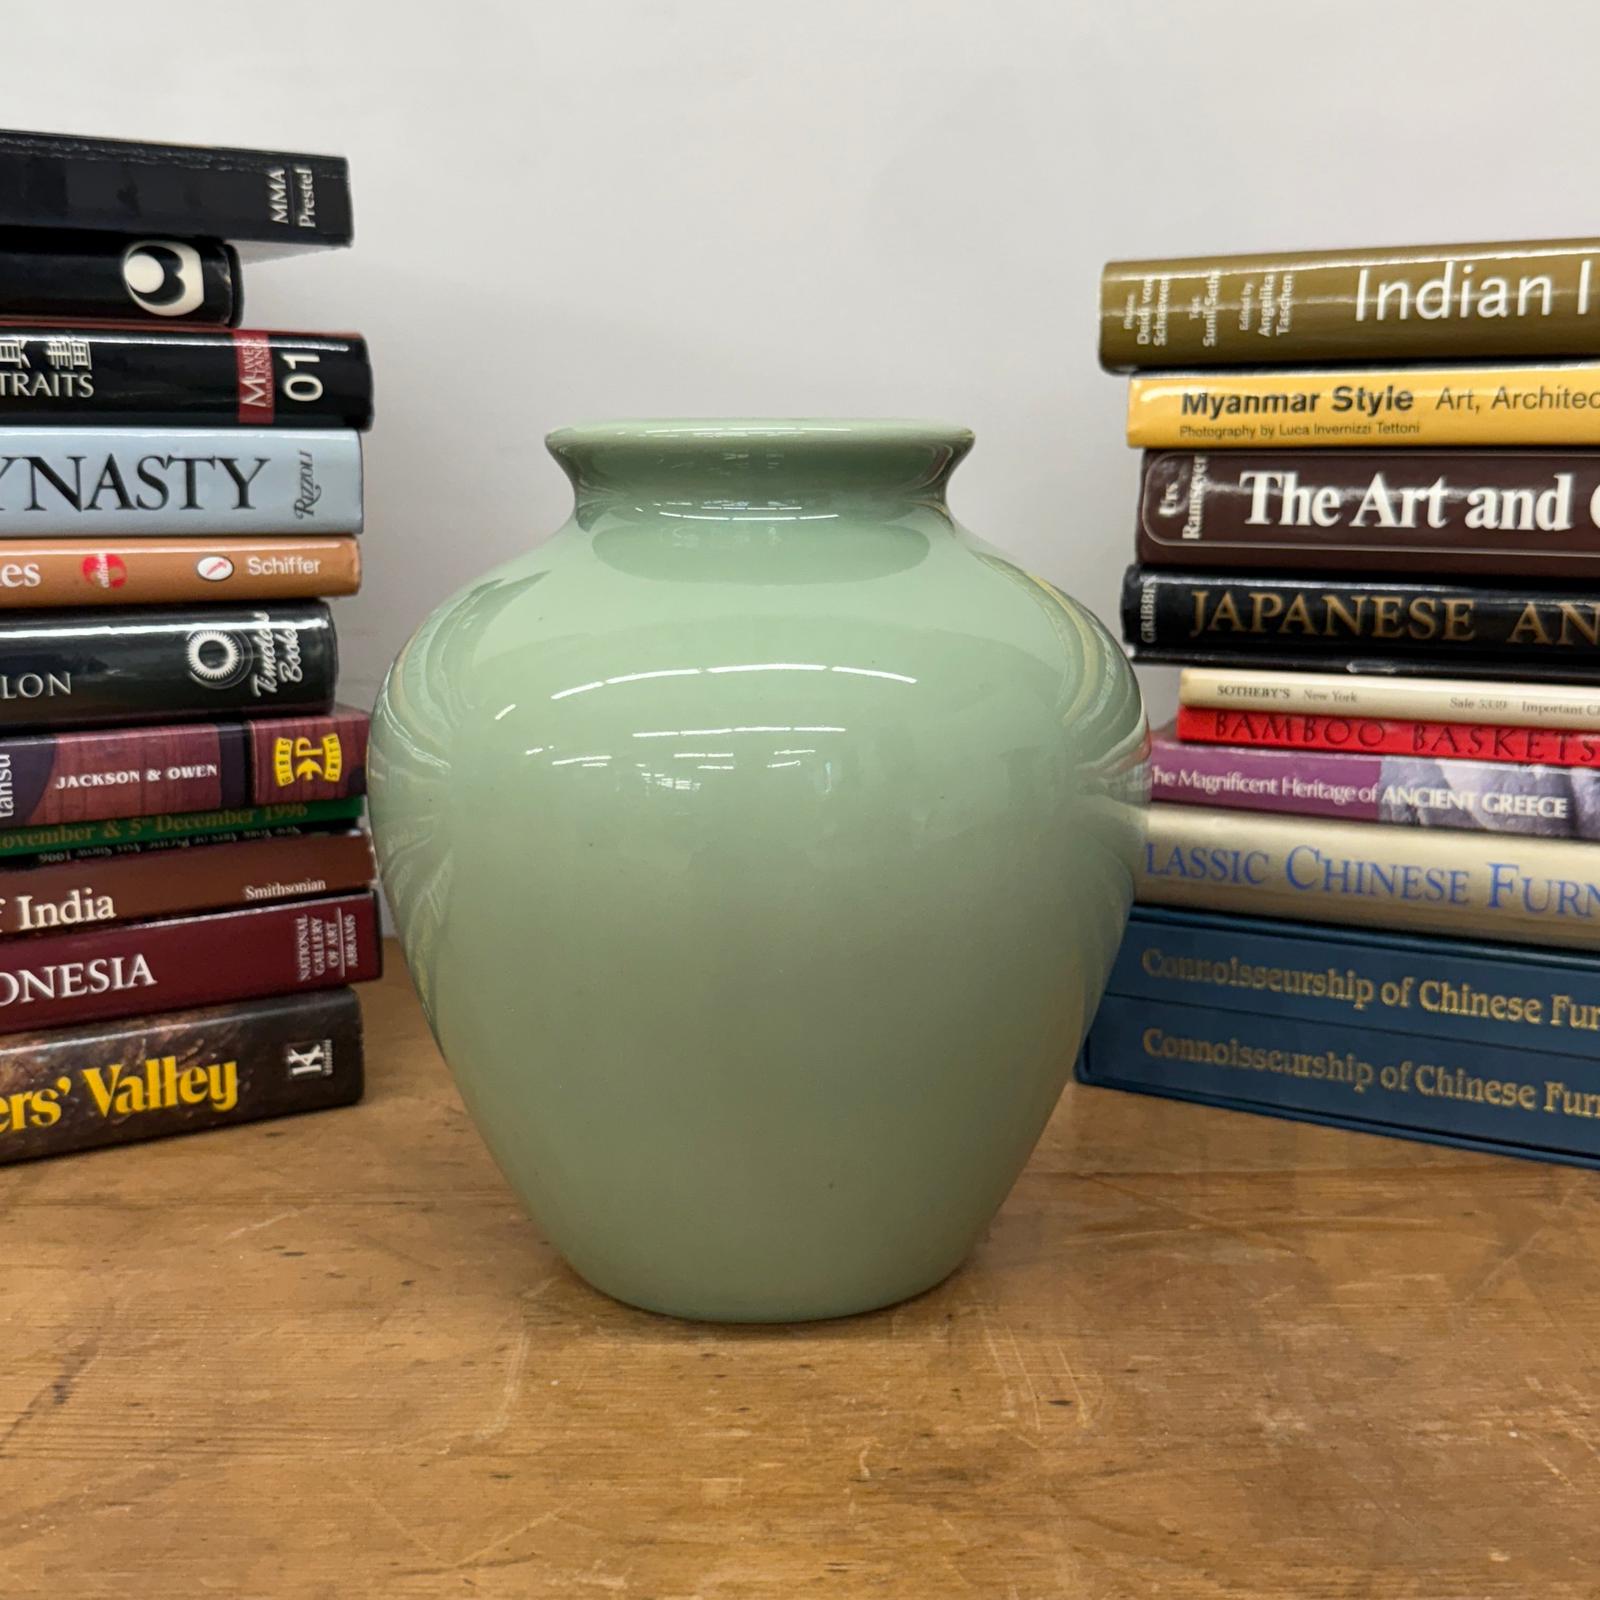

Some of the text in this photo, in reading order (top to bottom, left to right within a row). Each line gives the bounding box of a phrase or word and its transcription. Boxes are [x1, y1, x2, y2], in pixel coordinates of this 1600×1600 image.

[269, 168, 289, 224] MMA
[295, 168, 316, 227] Prestel
[1240, 281, 1254, 331] Edited by
[1258, 273, 1275, 337] Angelika
[1275, 275, 1292, 336] Taschen
[1355, 261, 1552, 322] Indian
[1136, 308, 1151, 345] Deidi
[1203, 310, 1217, 347] Sunil
[0, 372, 94, 398] TRAITS
[282, 352, 324, 402] 01
[1180, 385, 1600, 420] Myanmar Style Art, Architec
[1179, 421, 1420, 440] Photography by Luca Invernizzi Tettoni
[1158, 481, 1177, 517] Urs
[1182, 455, 1207, 540] Ramseyer
[1239, 470, 1342, 527] The
[1349, 472, 1449, 529] Art
[1464, 474, 1575, 532] and
[0, 562, 41, 587] es
[247, 555, 322, 577] Schiffer
[1189, 589, 1600, 645] JAPANESE AN
[0, 671, 72, 699] LON
[1217, 685, 1291, 699] SOTHEBY'S
[1304, 689, 1329, 702] New
[1332, 690, 1358, 703] York
[1449, 697, 1474, 709] Sale
[1522, 701, 1584, 716] Important
[1213, 713, 1597, 763] BAMBOO BASKETS
[55, 764, 217, 790] JACKSON & OWEN
[1152, 765, 1568, 819] he Magnificent Heritage of ANCIENT GREECE
[0, 825, 96, 850] ovember
[103, 820, 121, 838] &
[157, 809, 255, 832] December
[245, 878, 327, 901] Smithsonian
[1145, 841, 1270, 884] LASSIC
[1286, 844, 1471, 908] CHINESE
[16, 887, 117, 930] India
[296, 914, 311, 981] NATIONAL
[311, 917, 326, 976] GALLERY
[326, 921, 339, 967] OF ART
[344, 914, 358, 967] ABRAMS
[1141, 948, 1374, 1010] Connoisseurship
[1380, 977, 1415, 1008] of
[1419, 980, 1542, 1025] Chinese
[82, 1055, 238, 1118] Valley
[1142, 1028, 1373, 1093] Connoisseurship
[1380, 1060, 1412, 1091] of
[1415, 1065, 1537, 1109] Chinese
